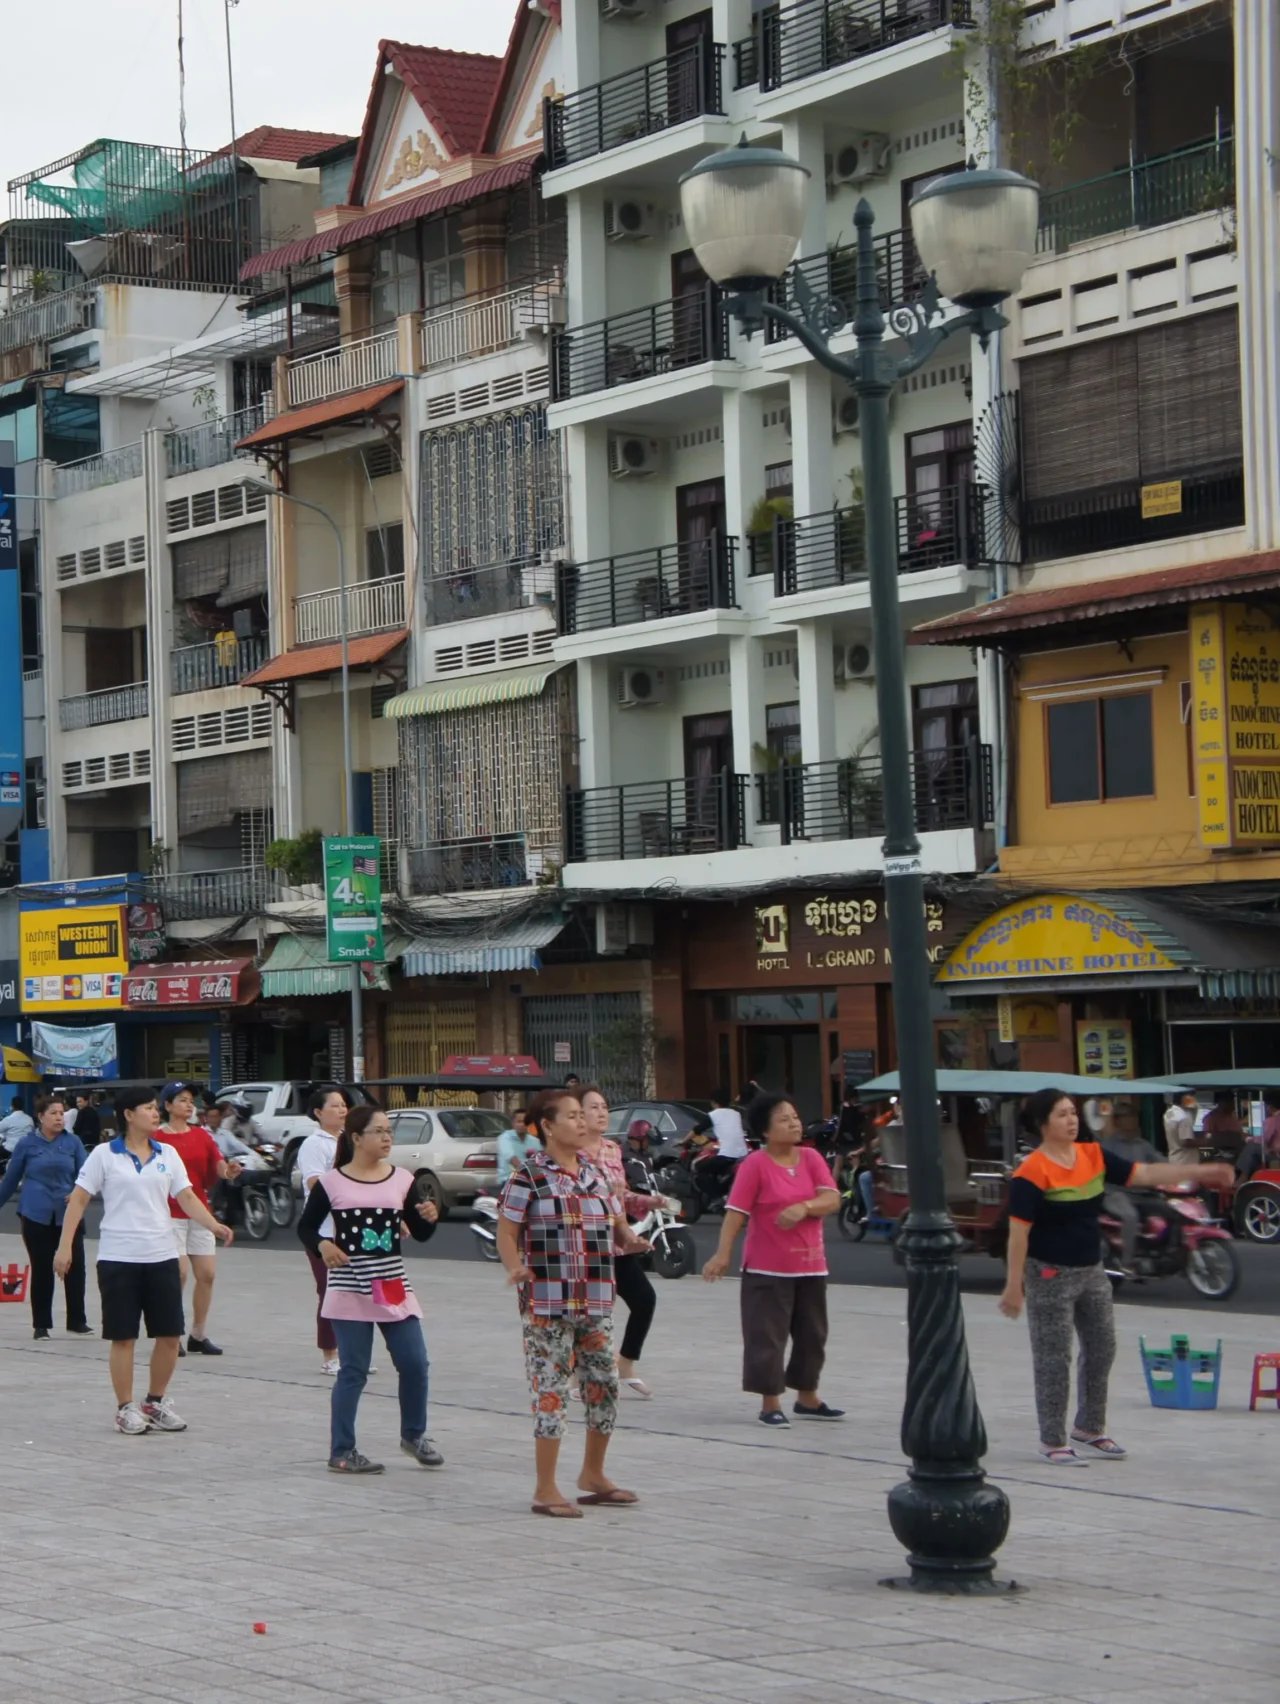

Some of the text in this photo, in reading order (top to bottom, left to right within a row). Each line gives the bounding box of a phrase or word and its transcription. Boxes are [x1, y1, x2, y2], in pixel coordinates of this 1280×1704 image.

[1235, 732, 1280, 750] HOTEL
[3, 791, 19, 799] VISA
[60, 925, 107, 941] WESTERN
[75, 941, 107, 955] UNION
[338, 946, 370, 957] Smart
[757, 958, 790, 970] HOTEL
[826, 949, 875, 967] GRAND
[947, 952, 1167, 976] INDOCHINE HOTEL
[85, 981, 101, 992] VISA
